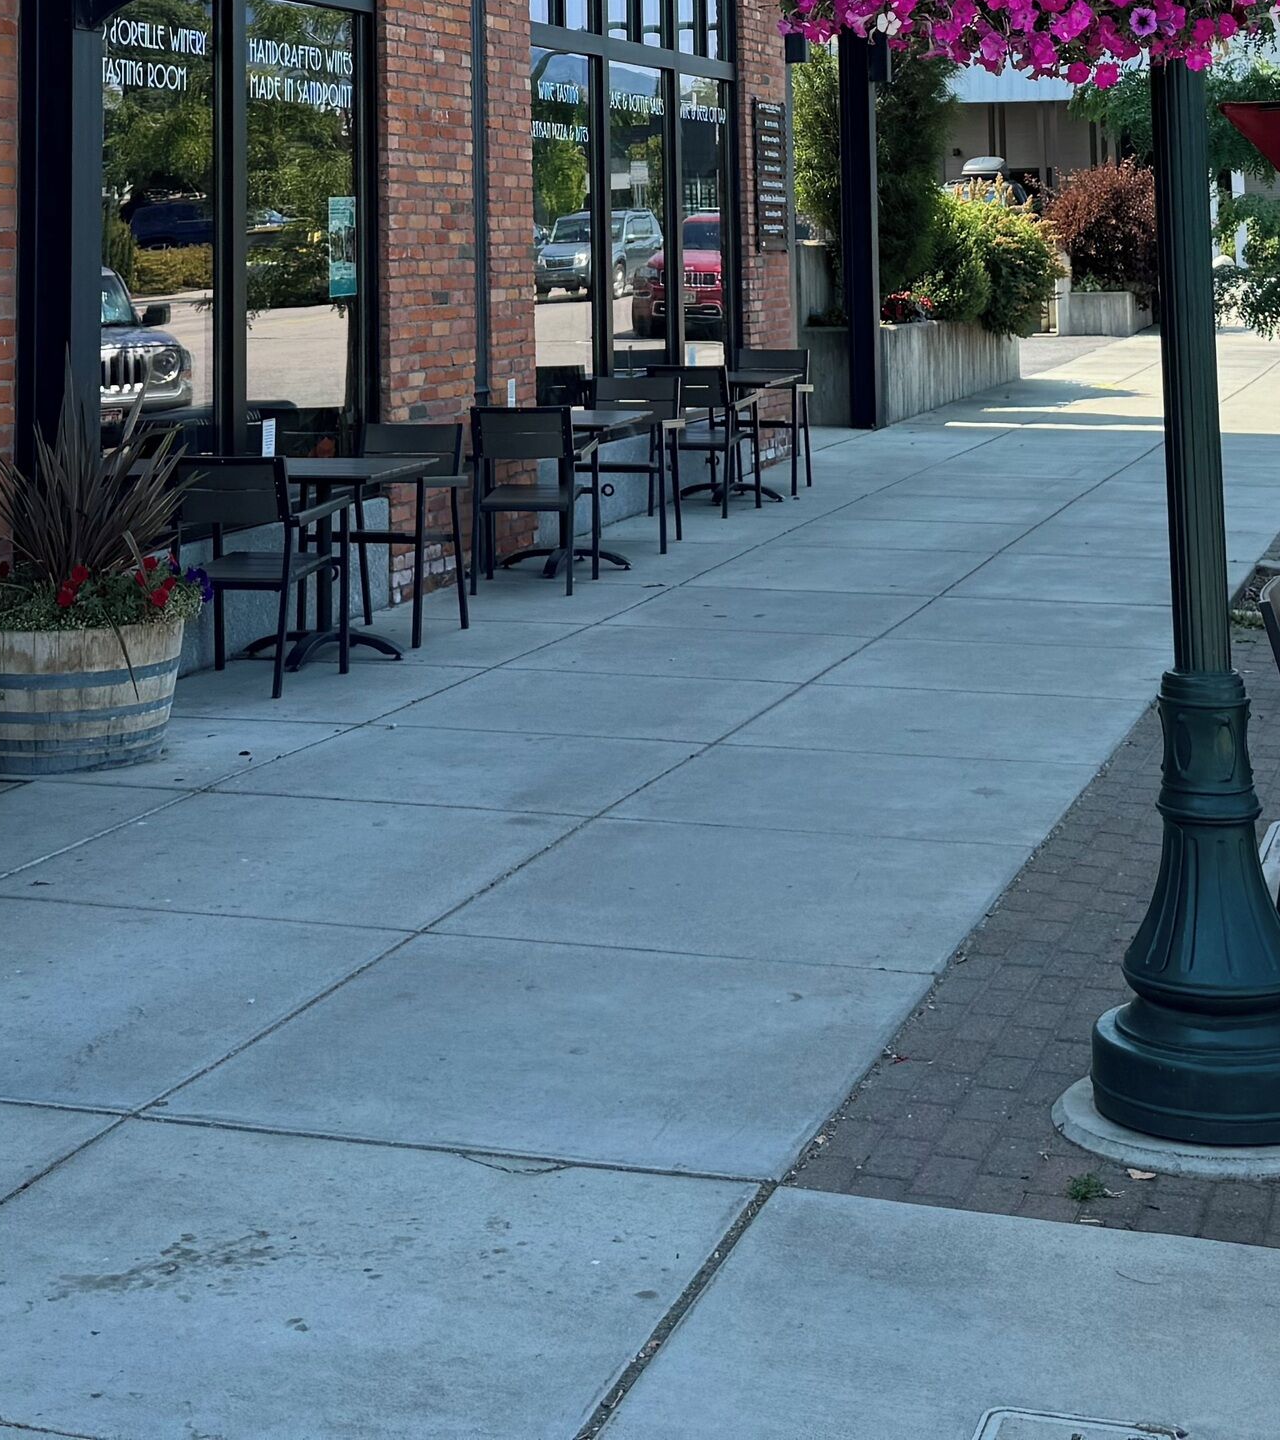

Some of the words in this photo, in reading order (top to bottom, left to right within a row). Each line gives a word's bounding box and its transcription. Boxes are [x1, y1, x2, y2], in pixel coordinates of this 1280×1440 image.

[169, 26, 207, 56] WINERY
[249, 38, 322, 71] HANDCRAFTED
[325, 49, 353, 75] WINES
[102, 57, 143, 87] TASTING
[147, 62, 186, 91] ROOM
[250, 73, 281, 100] MADE
[284, 77, 294, 103] IN
[297, 80, 353, 108] SANDPOINT
